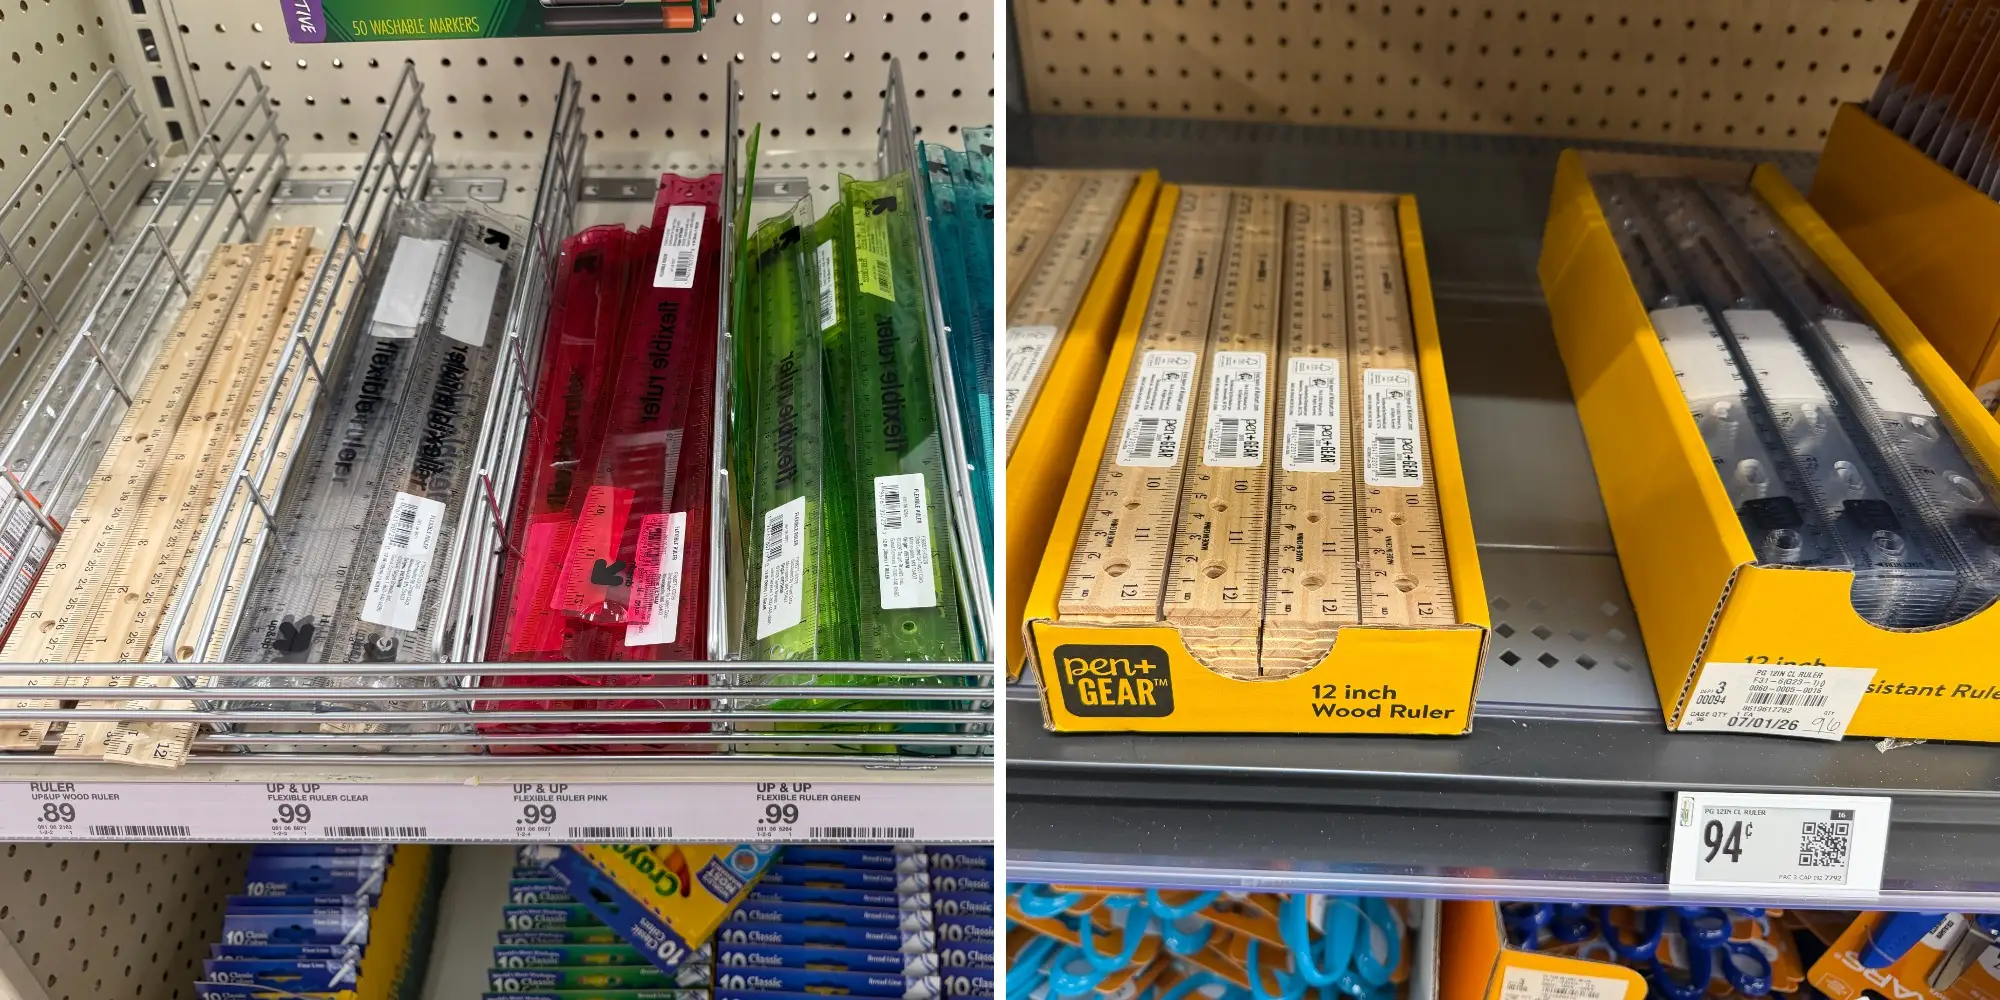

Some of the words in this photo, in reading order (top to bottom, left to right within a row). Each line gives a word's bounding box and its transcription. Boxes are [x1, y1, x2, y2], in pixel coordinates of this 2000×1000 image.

[295, 0, 316, 33] TIVE
[353, 20, 369, 36] 50
[370, 18, 425, 34] WASHABLE
[430, 16, 480, 33] MARKERS
[1146, 477, 1161, 488] 10
[1234, 479, 1248, 491] 10
[1322, 490, 1335, 502] 10
[1405, 494, 1419, 505] 10
[1135, 528, 1150, 538] 11
[1229, 530, 1243, 541] 11
[1322, 542, 1336, 553] 11
[1411, 545, 1426, 556] 11
[1121, 584, 1138, 598] 12
[1223, 586, 1238, 600] 12
[1322, 599, 1338, 613] 12
[1418, 602, 1434, 616] 12
[1064, 658, 1156, 685] pen+
[1312, 684, 1336, 699] 12
[1345, 685, 1396, 699] inch
[1716, 681, 1727, 694] 3
[1865, 680, 1946, 696] sistant
[1950, 684, 2000, 700] Rule
[1696, 695, 1727, 704] 00094
[1312, 703, 1381, 718] Wood
[1390, 704, 1455, 719] Ruler
[1727, 716, 1800, 730] 07/01/26
[1812, 718, 1840, 733] 96
[153, 743, 169, 758] 12
[31, 783, 75, 792] RULER
[266, 784, 284, 793] UP
[289, 784, 298, 793] &
[302, 784, 320, 793] UP
[513, 784, 532, 793] UP
[536, 784, 545, 793] &
[549, 784, 568, 793] UP
[757, 783, 775, 792] UP
[780, 783, 788, 792] &
[793, 783, 812, 792] UP
[38, 803, 75, 822] .89
[272, 804, 311, 823] .99
[517, 804, 556, 824] .99
[758, 804, 798, 824] .99
[935, 899, 958, 915] 10
[938, 922, 962, 941] 10
[657, 940, 685, 966] 10
[721, 952, 748, 966] 10
[941, 948, 966, 967] 10
[720, 974, 746, 990] 10
[944, 975, 970, 996] 10
